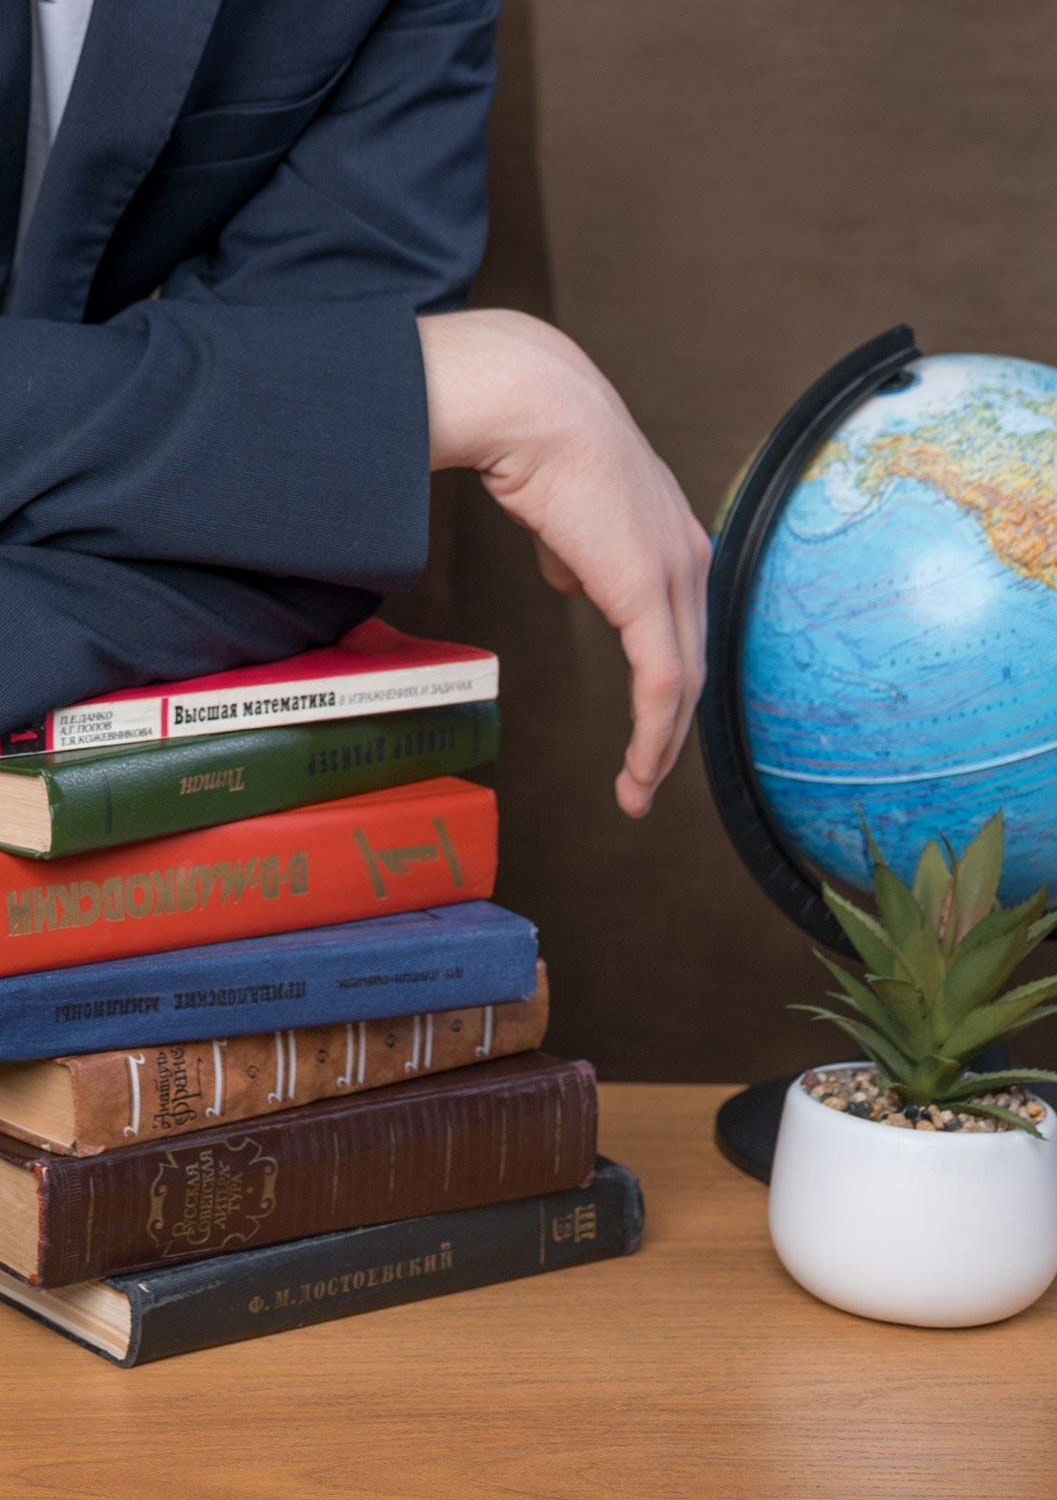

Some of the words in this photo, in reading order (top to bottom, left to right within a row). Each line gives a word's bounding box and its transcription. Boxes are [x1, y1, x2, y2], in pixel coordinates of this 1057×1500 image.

[174, 703, 237, 725] Высшая
[243, 691, 336, 716] математика
[179, 766, 245, 795] Титан
[55, 995, 161, 1023] МИЛЛИОНЫ
[173, 980, 307, 1011] ПРИВАЛОВСКИЕ
[170, 1047, 202, 1125] Франс
